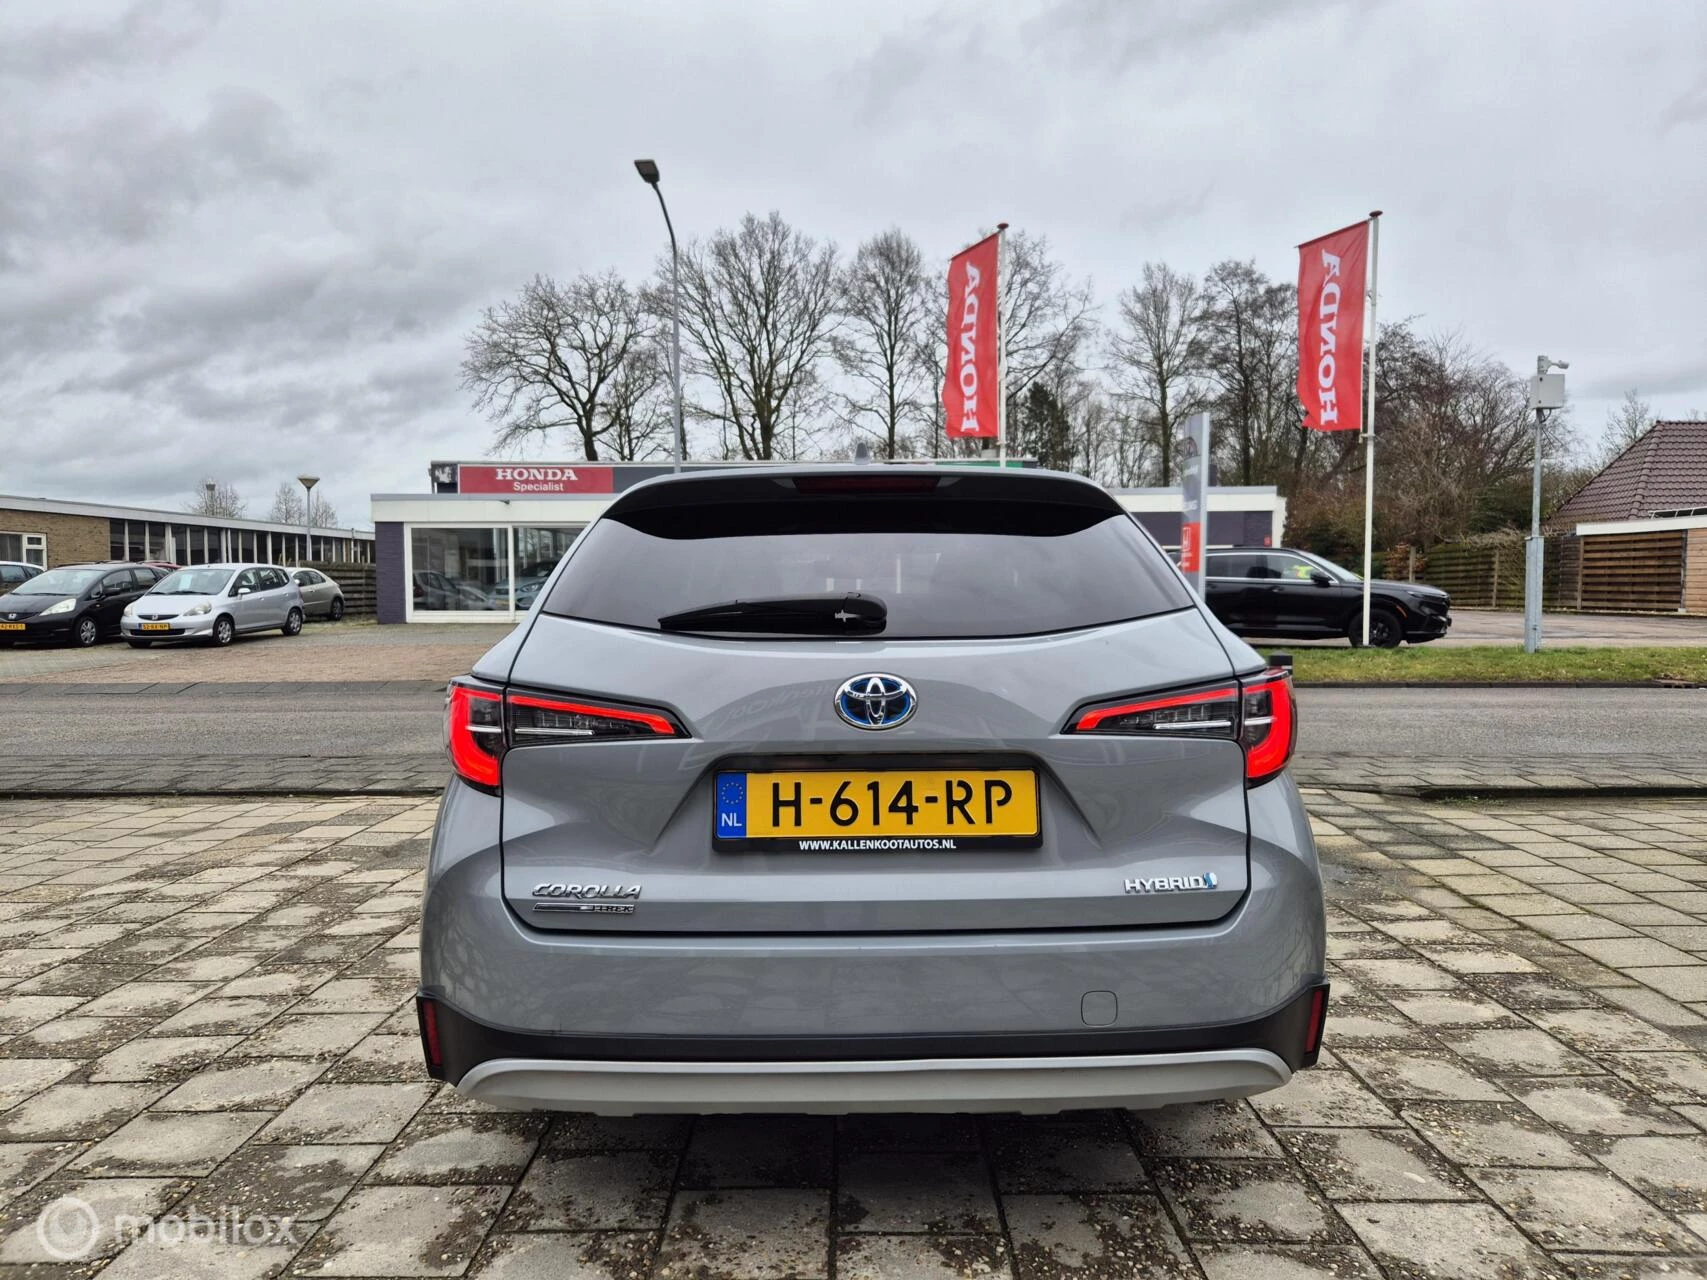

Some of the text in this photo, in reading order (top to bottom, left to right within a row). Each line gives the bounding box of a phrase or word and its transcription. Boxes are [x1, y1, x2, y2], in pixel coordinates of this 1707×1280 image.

[1318, 249, 1341, 426] HONDA
[959, 261, 981, 432] HONDA
[495, 468, 578, 481] HONDA
[513, 481, 564, 492] Specialist
[721, 779, 1013, 827] NL H-614-RP
[799, 838, 957, 851] WWW.KALLENKOOTAUTOS.NL
[532, 883, 642, 899] COROLLA
[1124, 876, 1207, 894] HYBRID
